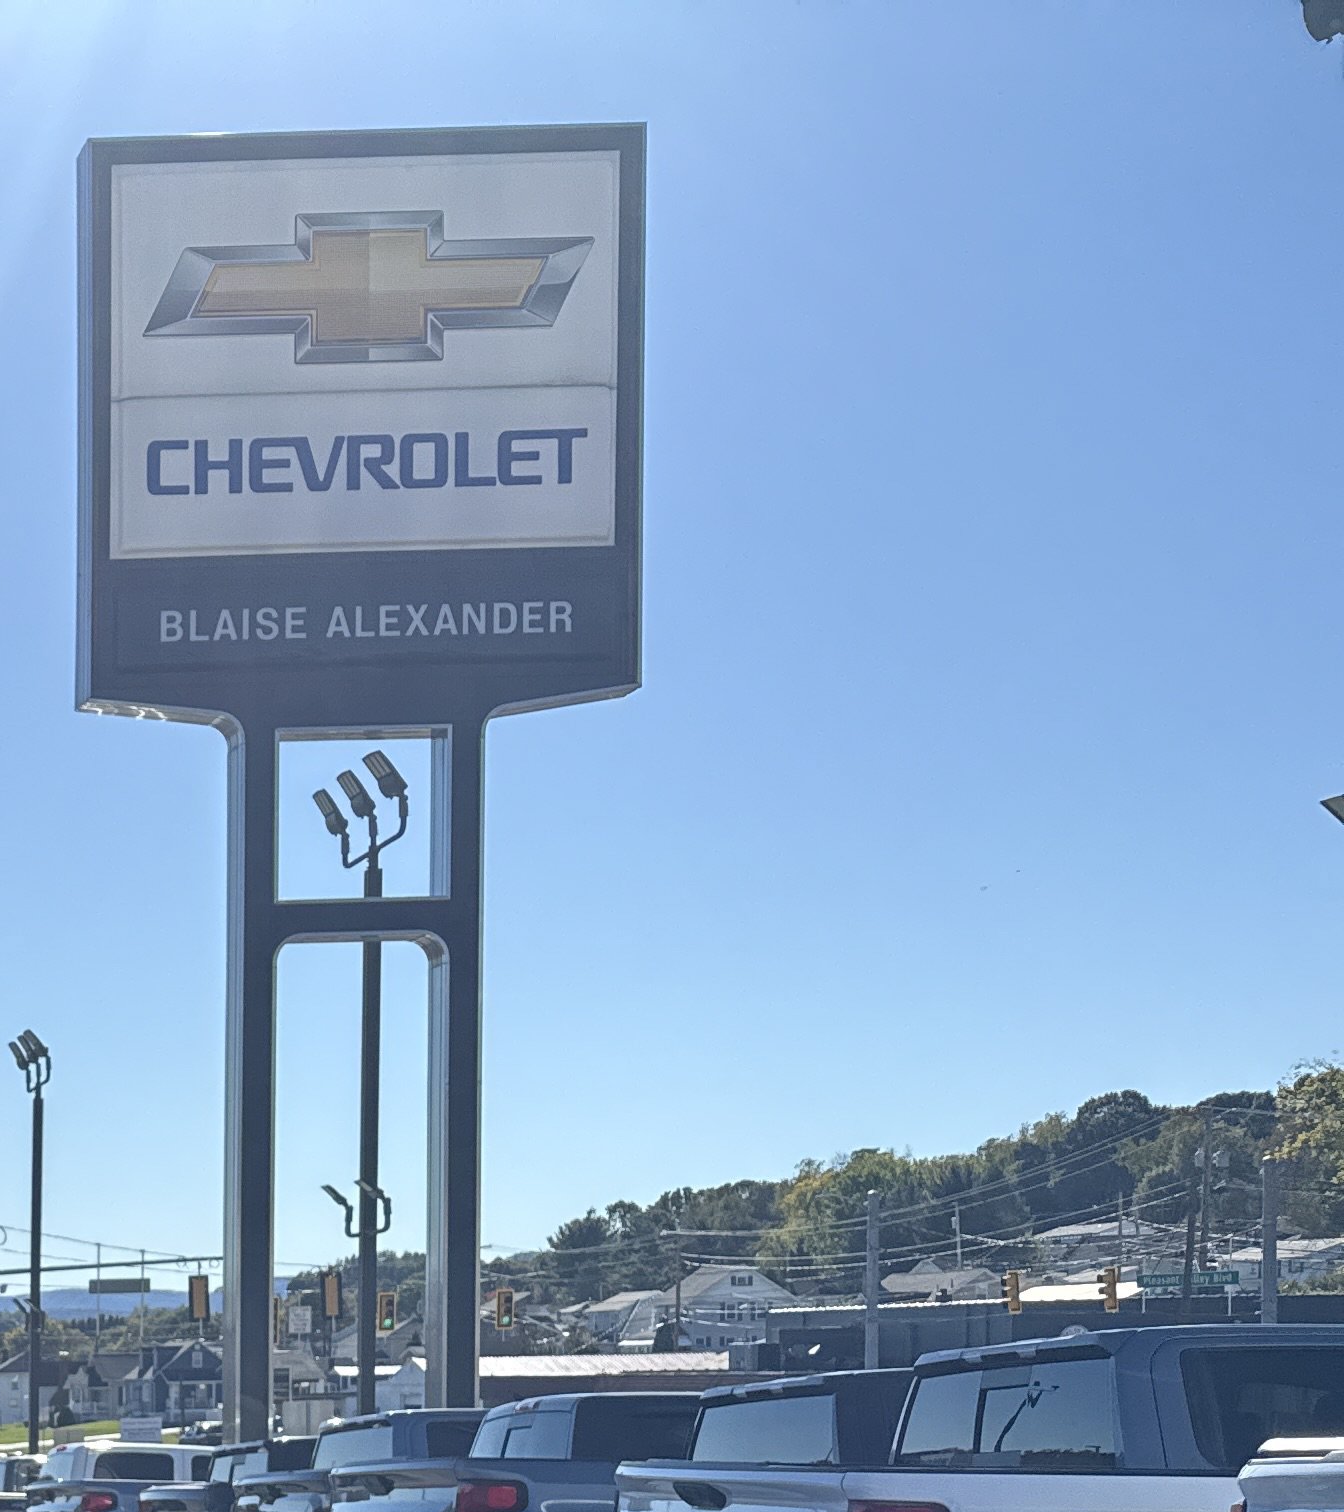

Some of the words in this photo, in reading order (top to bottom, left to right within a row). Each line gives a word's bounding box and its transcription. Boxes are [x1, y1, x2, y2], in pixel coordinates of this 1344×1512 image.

[146, 427, 588, 496] CHEVROLET
[160, 606, 308, 643] BLAISE
[326, 600, 574, 639] ALEXANDER
